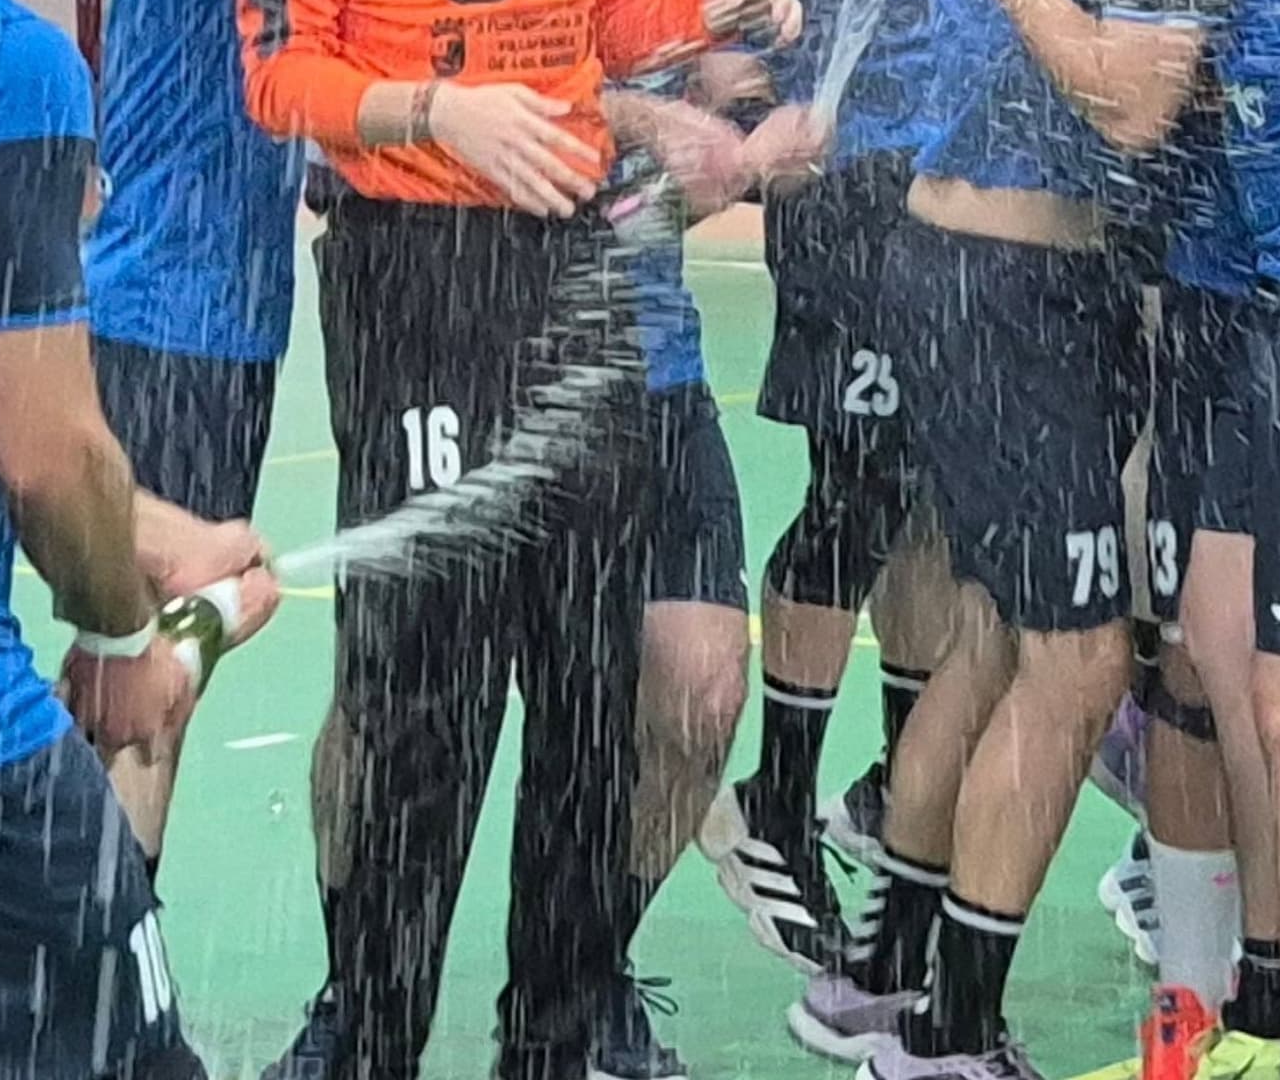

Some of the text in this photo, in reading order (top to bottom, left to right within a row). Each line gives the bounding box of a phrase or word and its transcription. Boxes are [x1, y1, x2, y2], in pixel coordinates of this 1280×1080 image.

[402, 405, 462, 491] 16
[1065, 524, 1119, 607] 79
[1148, 521, 1178, 597] 3
